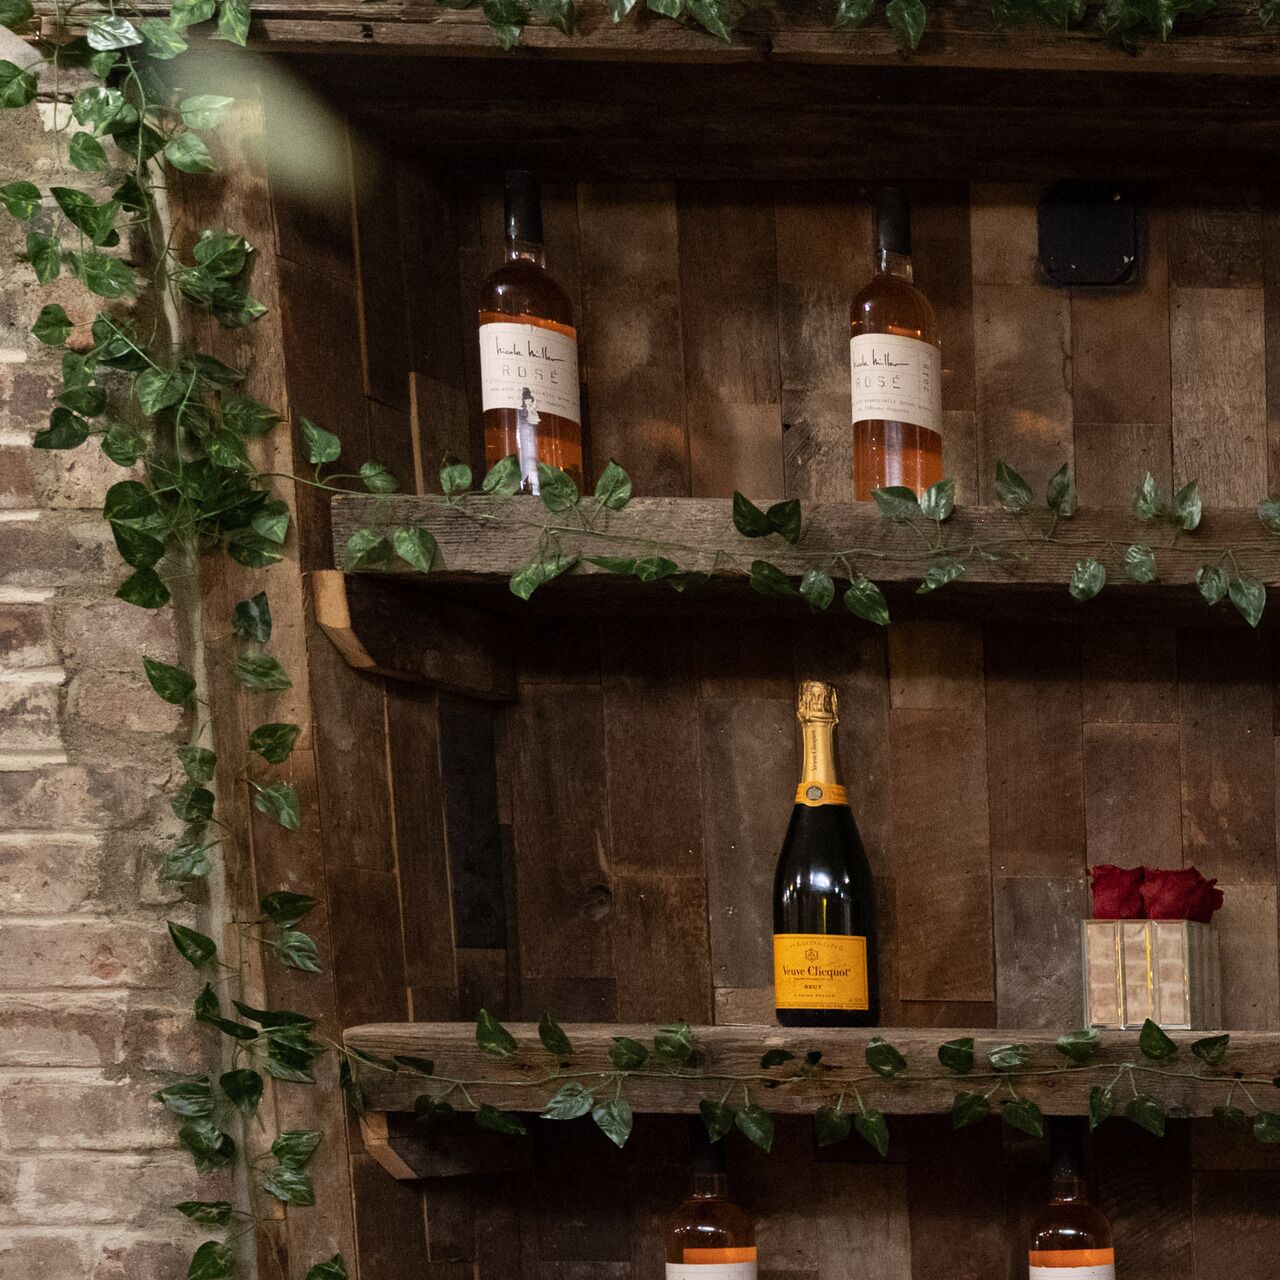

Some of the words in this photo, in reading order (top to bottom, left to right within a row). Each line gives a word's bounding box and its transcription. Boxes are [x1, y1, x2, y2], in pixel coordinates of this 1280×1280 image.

[502, 364, 559, 384] ROSÉ
[855, 375, 901, 390] ROSÉ
[782, 965, 806, 976] Veuve
[807, 965, 850, 978] Clicquot
